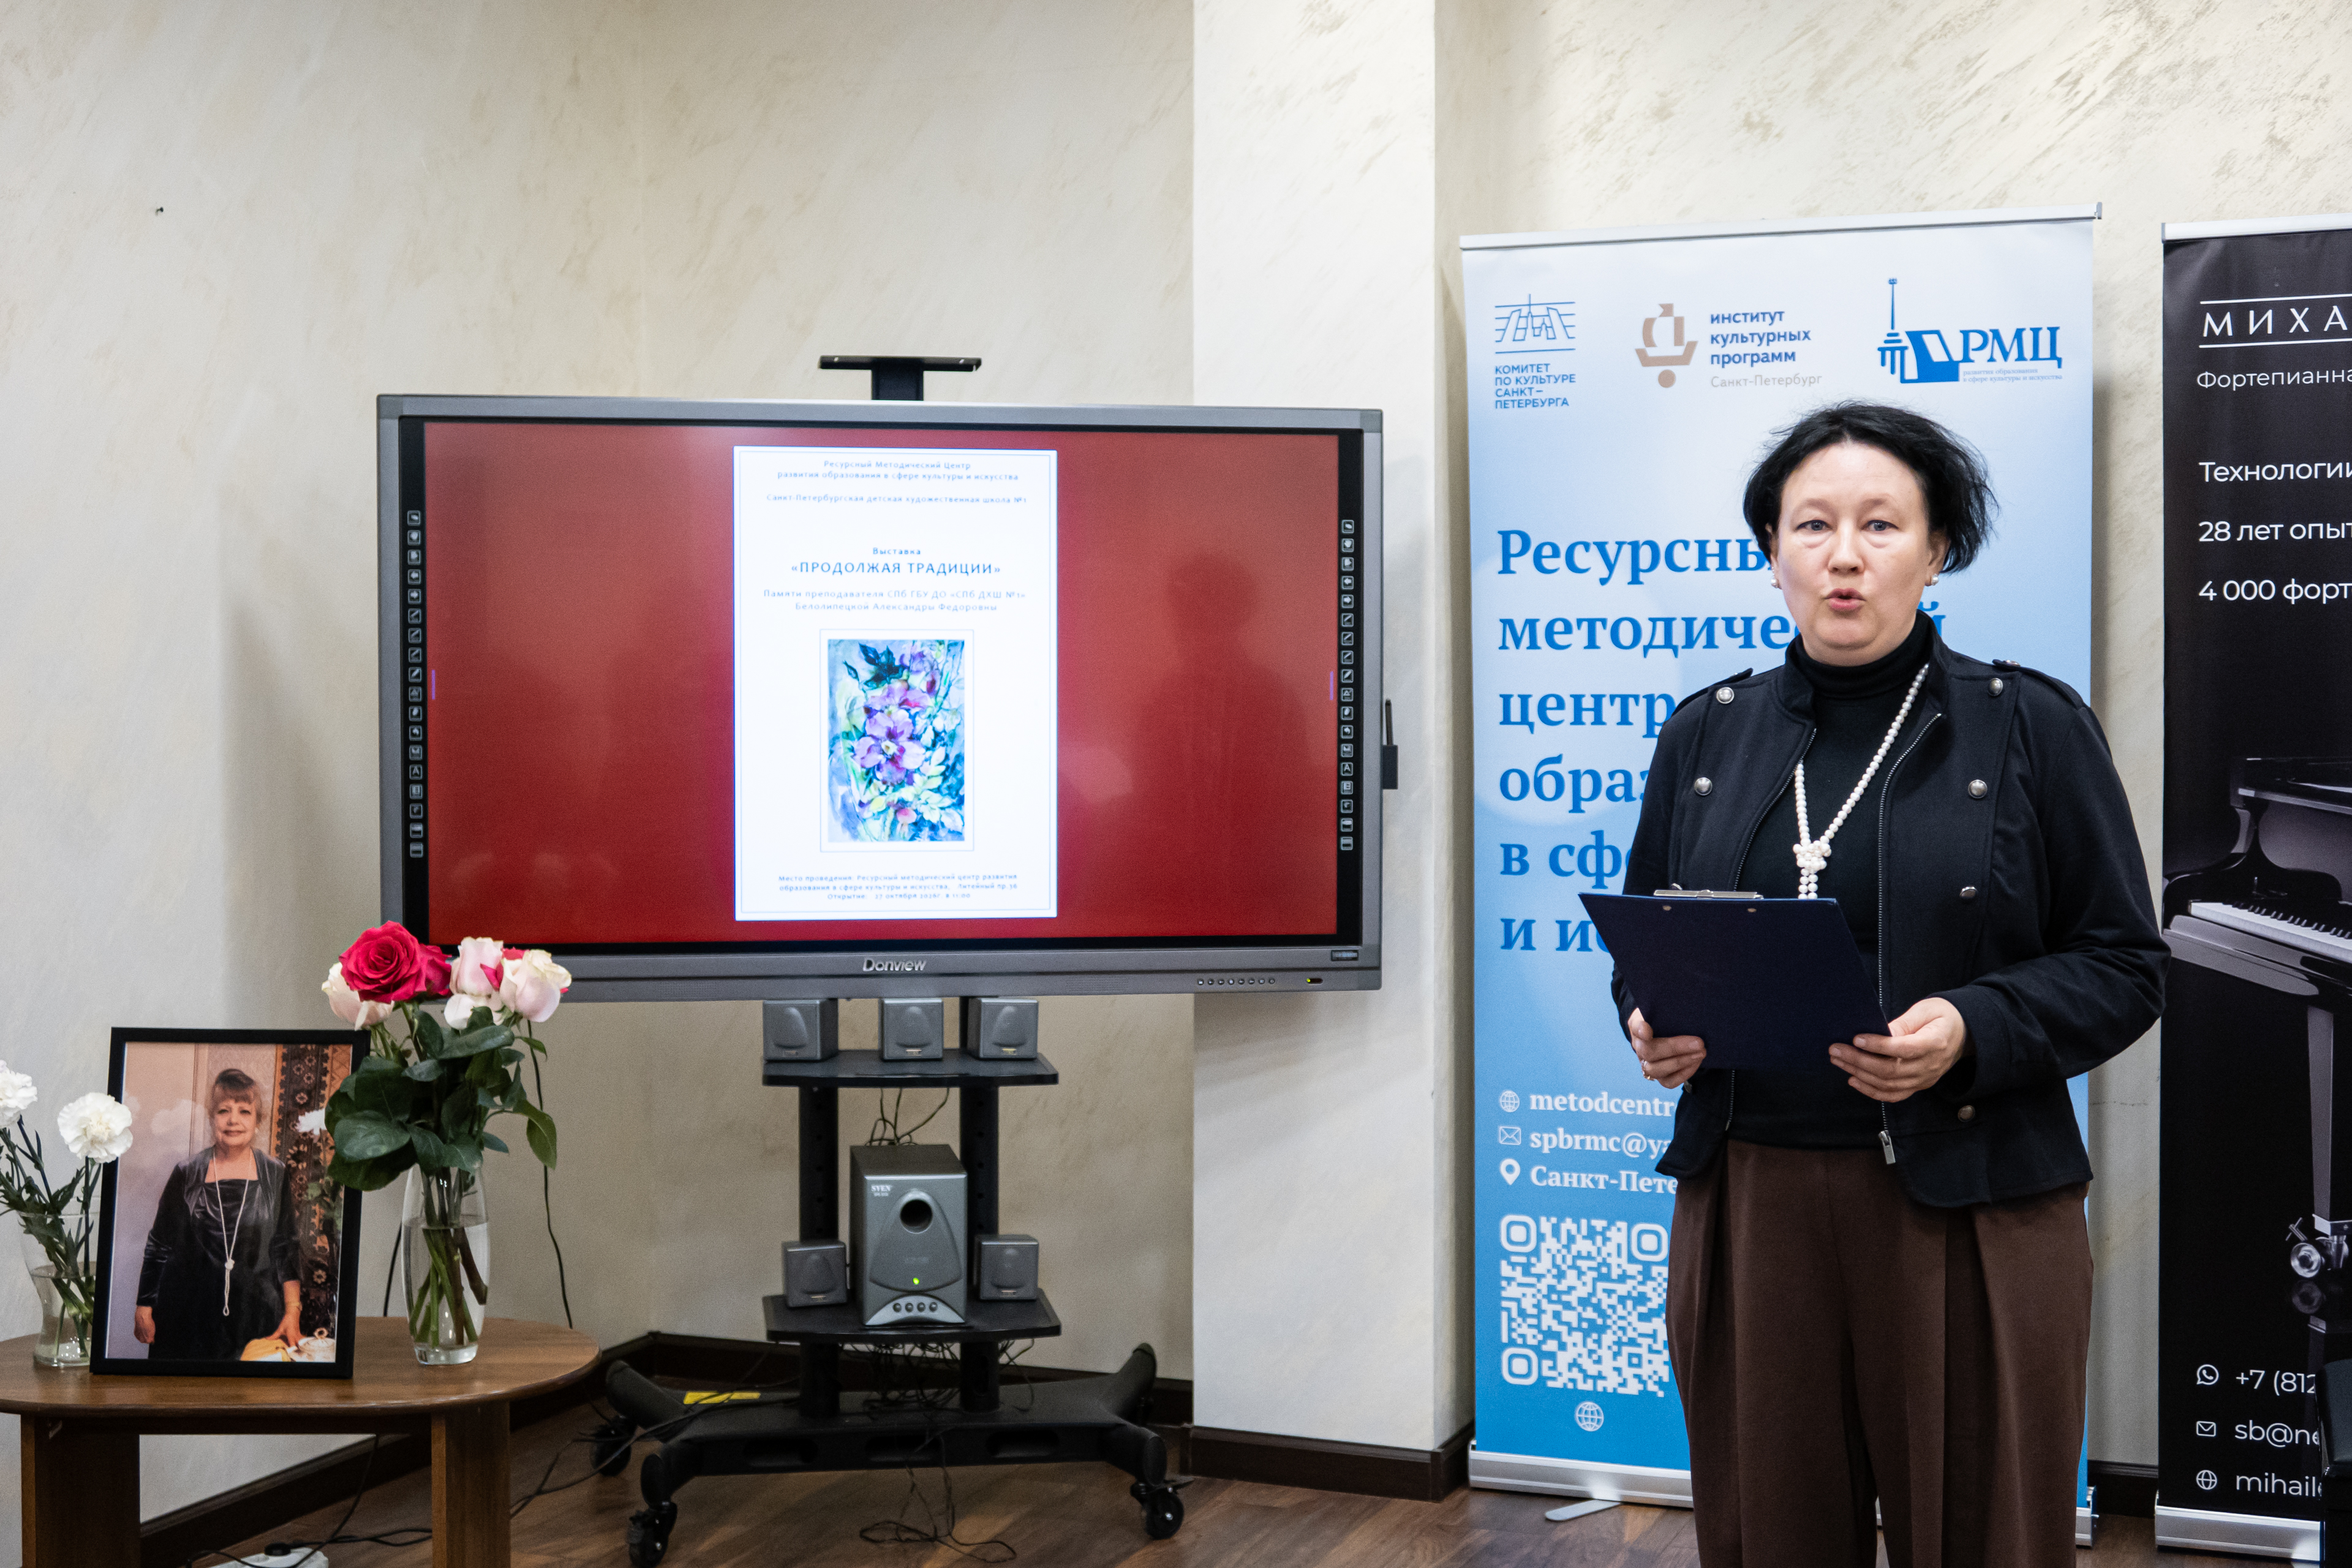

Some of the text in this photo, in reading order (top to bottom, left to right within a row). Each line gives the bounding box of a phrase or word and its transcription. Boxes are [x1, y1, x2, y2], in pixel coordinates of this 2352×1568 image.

[1710, 311, 1785, 326] институт
[1710, 330, 1811, 349] культурных
[1959, 326, 2062, 369] РМЦ
[1494, 363, 1551, 374] КОМИТЕТ
[1710, 349, 1796, 369] программ
[1494, 372, 1576, 386] ПО КУЛЬТУРЕ
[1709, 372, 1823, 388] Санкт-Петербург
[1494, 396, 1569, 409] ПЕТЕРБУРГА
[943, 462, 971, 471] Центр
[2198, 521, 2231, 542] 28
[2236, 524, 2285, 541] лет
[872, 546, 921, 556] Выставка
[1498, 529, 1771, 586] Ресурсны
[791, 562, 1000, 577] «ПРОДОЛЖАЯ ТРАДИЦИИ»
[2198, 581, 2217, 601] 4
[2223, 579, 2275, 601] 000
[1498, 600, 1946, 658] методиче
[1499, 692, 1676, 738] центр
[1499, 753, 1649, 814] обра
[1500, 830, 1632, 889] в сф
[1500, 919, 1611, 953] и и
[862, 958, 926, 971] Donview
[1530, 1091, 1675, 1117] metodcentr
[2235, 1368, 2266, 1390] +7
[2236, 1472, 2322, 1497] mihail
